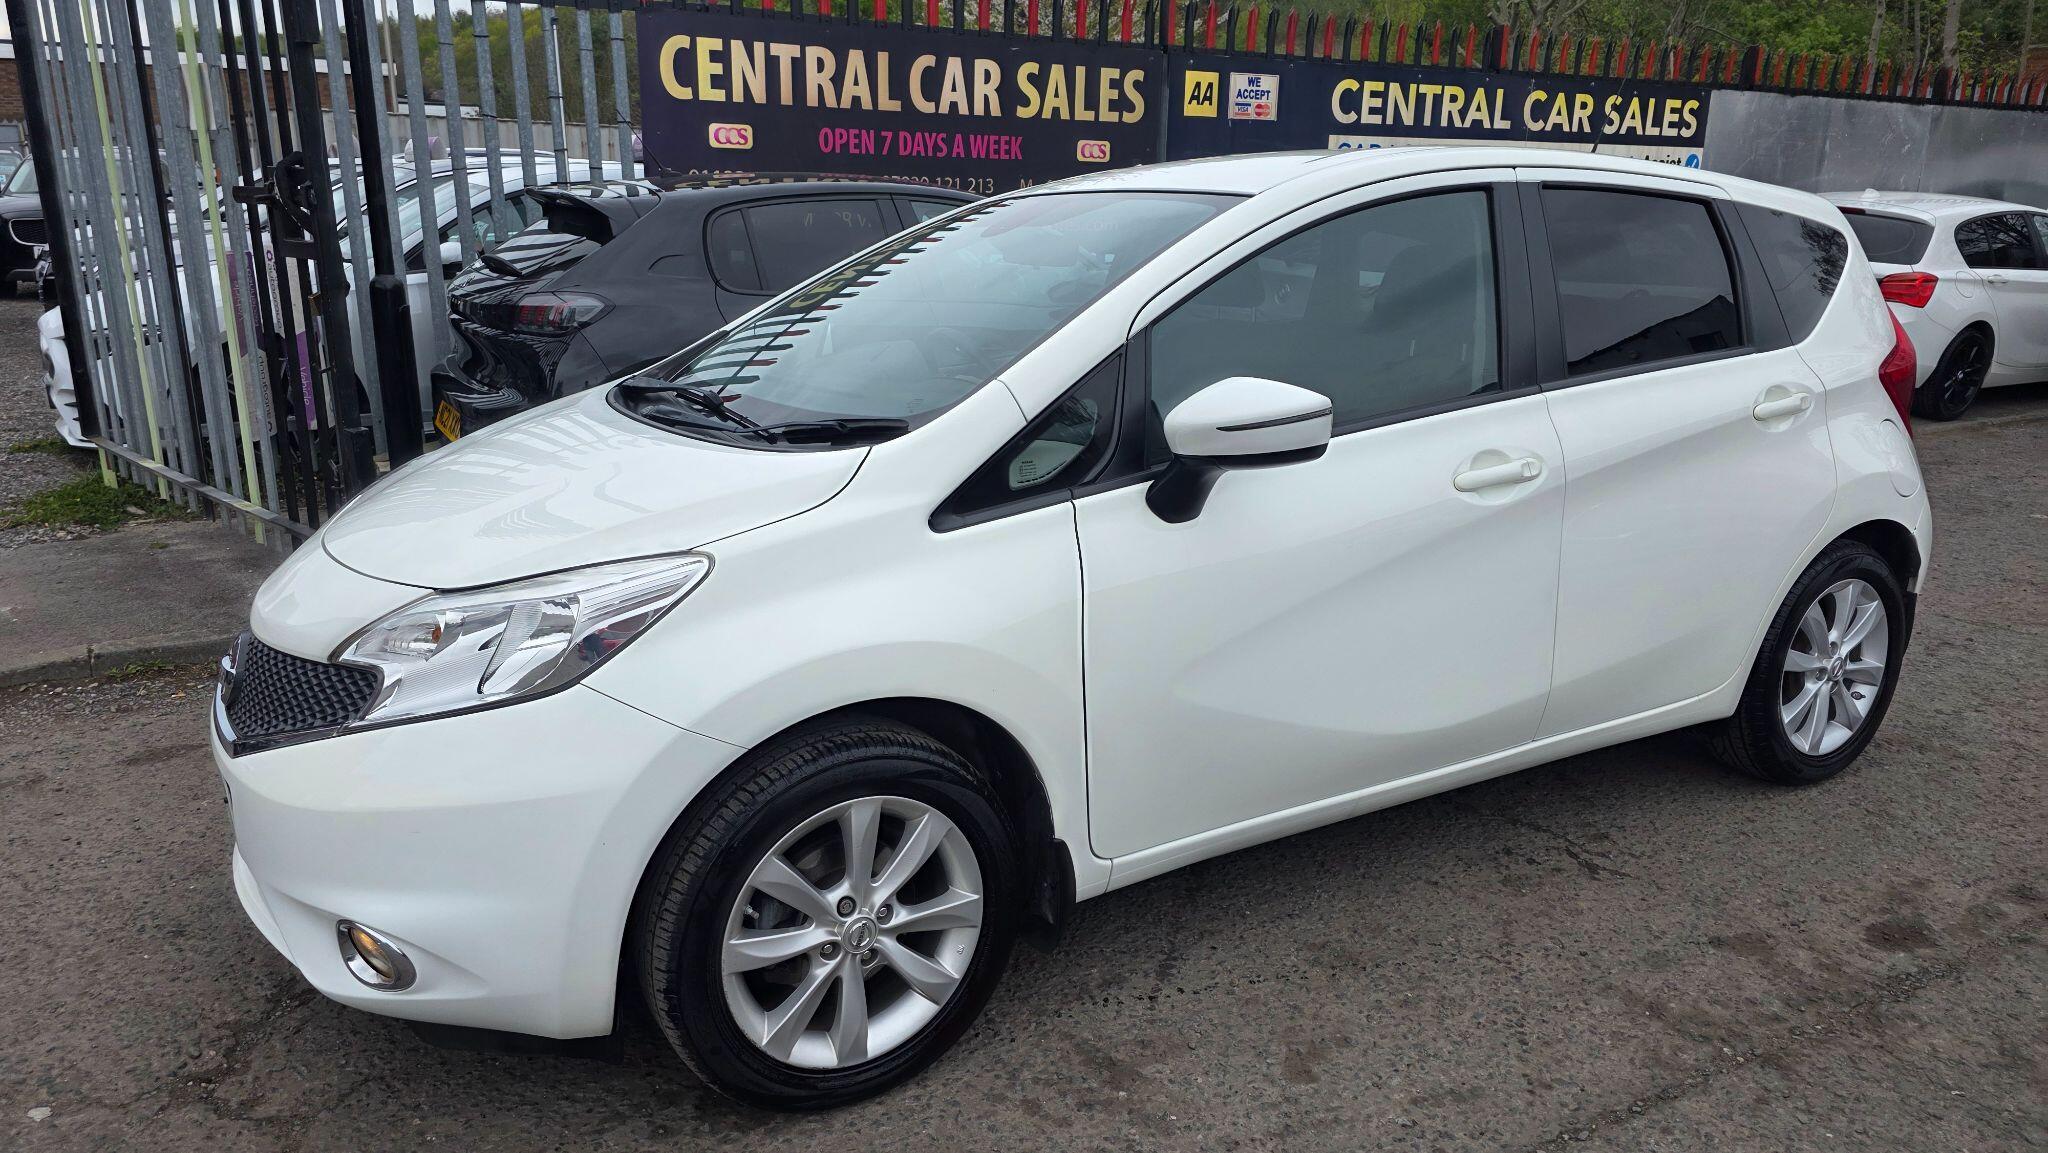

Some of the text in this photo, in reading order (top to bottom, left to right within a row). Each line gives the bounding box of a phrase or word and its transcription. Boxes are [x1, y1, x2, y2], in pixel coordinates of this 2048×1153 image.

[660, 35, 1145, 124] CENTRAL CAR SALES
[1247, 76, 1262, 88] WE
[1187, 81, 1214, 106] AA
[1236, 89, 1271, 101] ACCEPT
[1331, 78, 1700, 138] CENTRAL CAR SALES
[713, 126, 749, 146] CCS
[820, 127, 1023, 160] OPEN 7 DAYS A WEEK
[1080, 143, 1107, 159] CCS
[968, 178, 994, 193] 213
